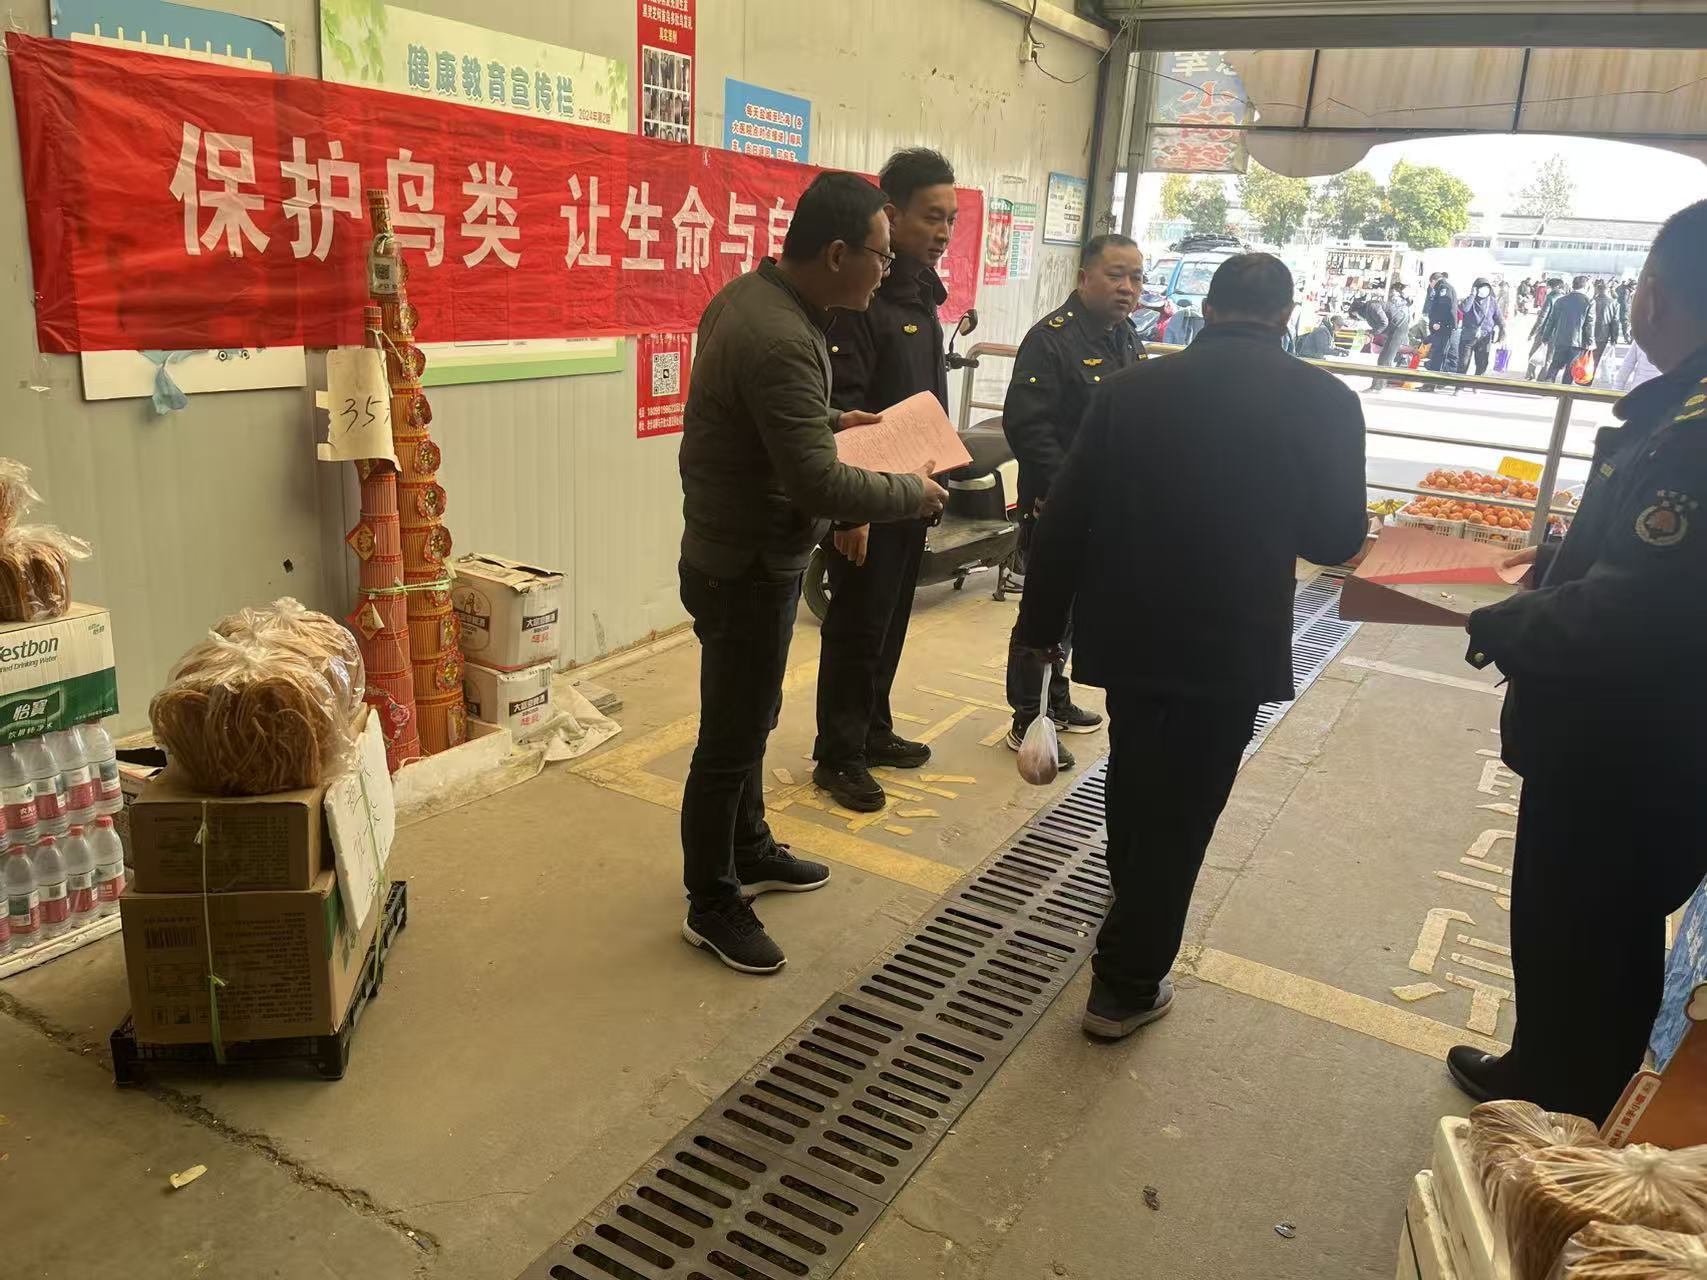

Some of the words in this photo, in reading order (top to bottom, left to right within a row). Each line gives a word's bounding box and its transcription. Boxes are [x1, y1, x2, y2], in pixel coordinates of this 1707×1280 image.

[407, 42, 575, 118] 健康教育宣传栏
[169, 121, 522, 269] 保护鸟类
[13, 659, 39, 671] Drinking
[39, 655, 58, 665] Water
[13, 699, 48, 721] 怡寶
